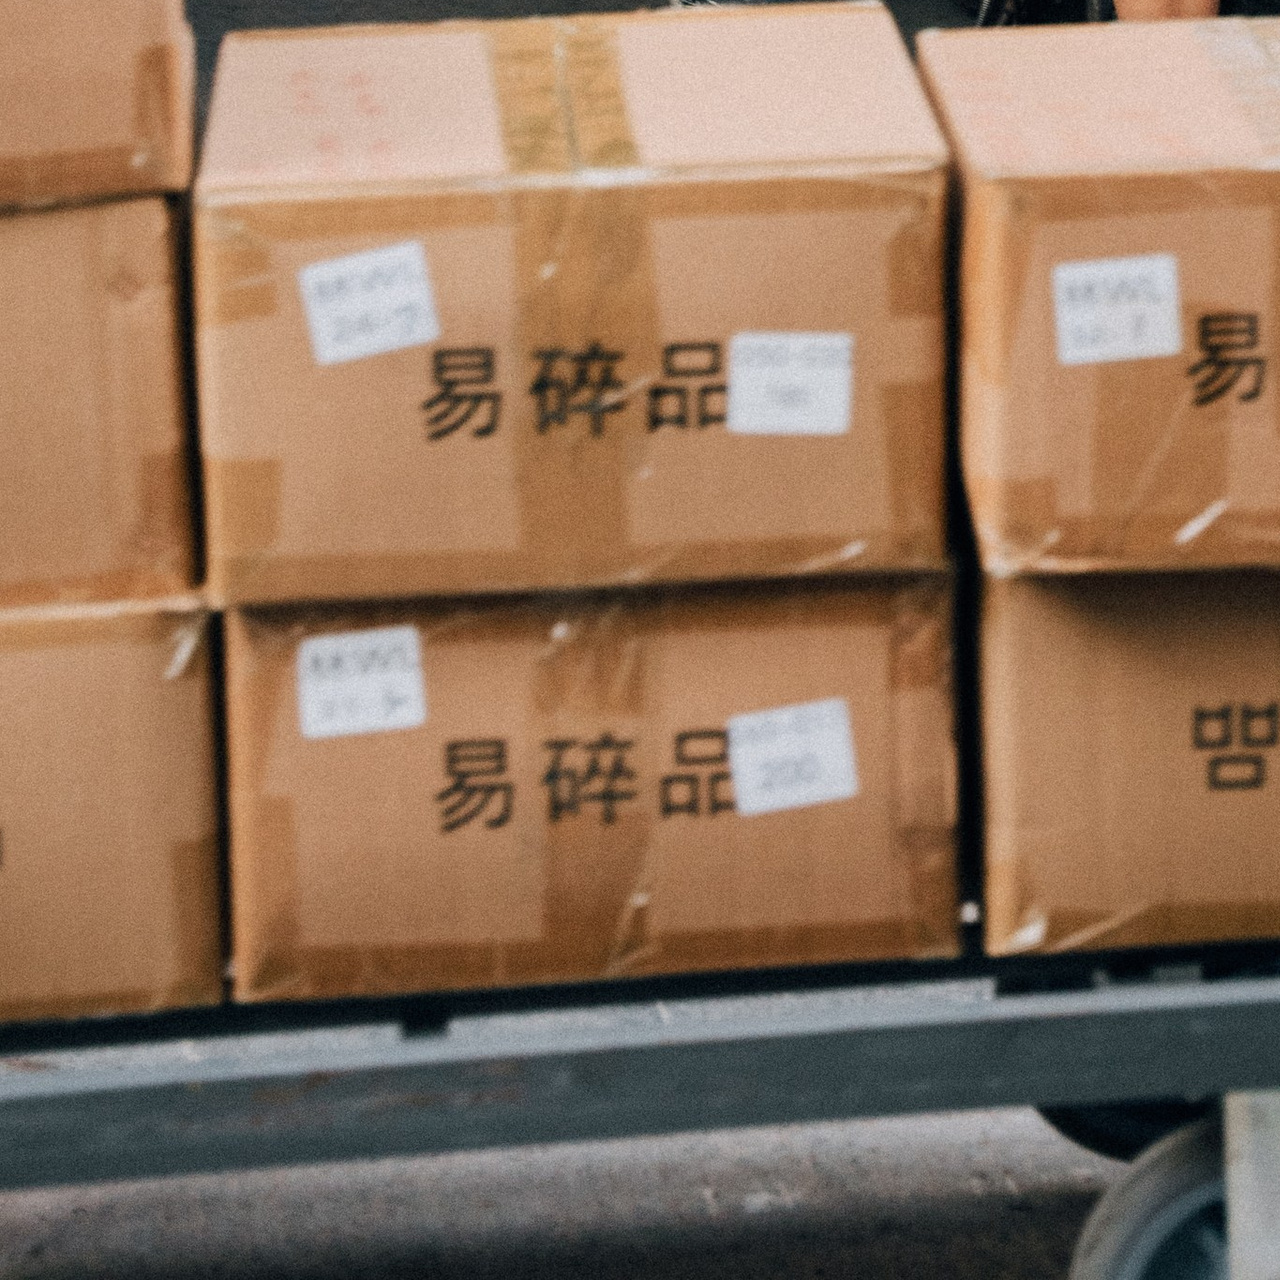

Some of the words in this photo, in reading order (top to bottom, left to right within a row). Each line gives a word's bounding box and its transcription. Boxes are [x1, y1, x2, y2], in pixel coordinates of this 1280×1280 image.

[421, 340, 728, 441] 易碎品
[434, 730, 737, 833] 易碎品
